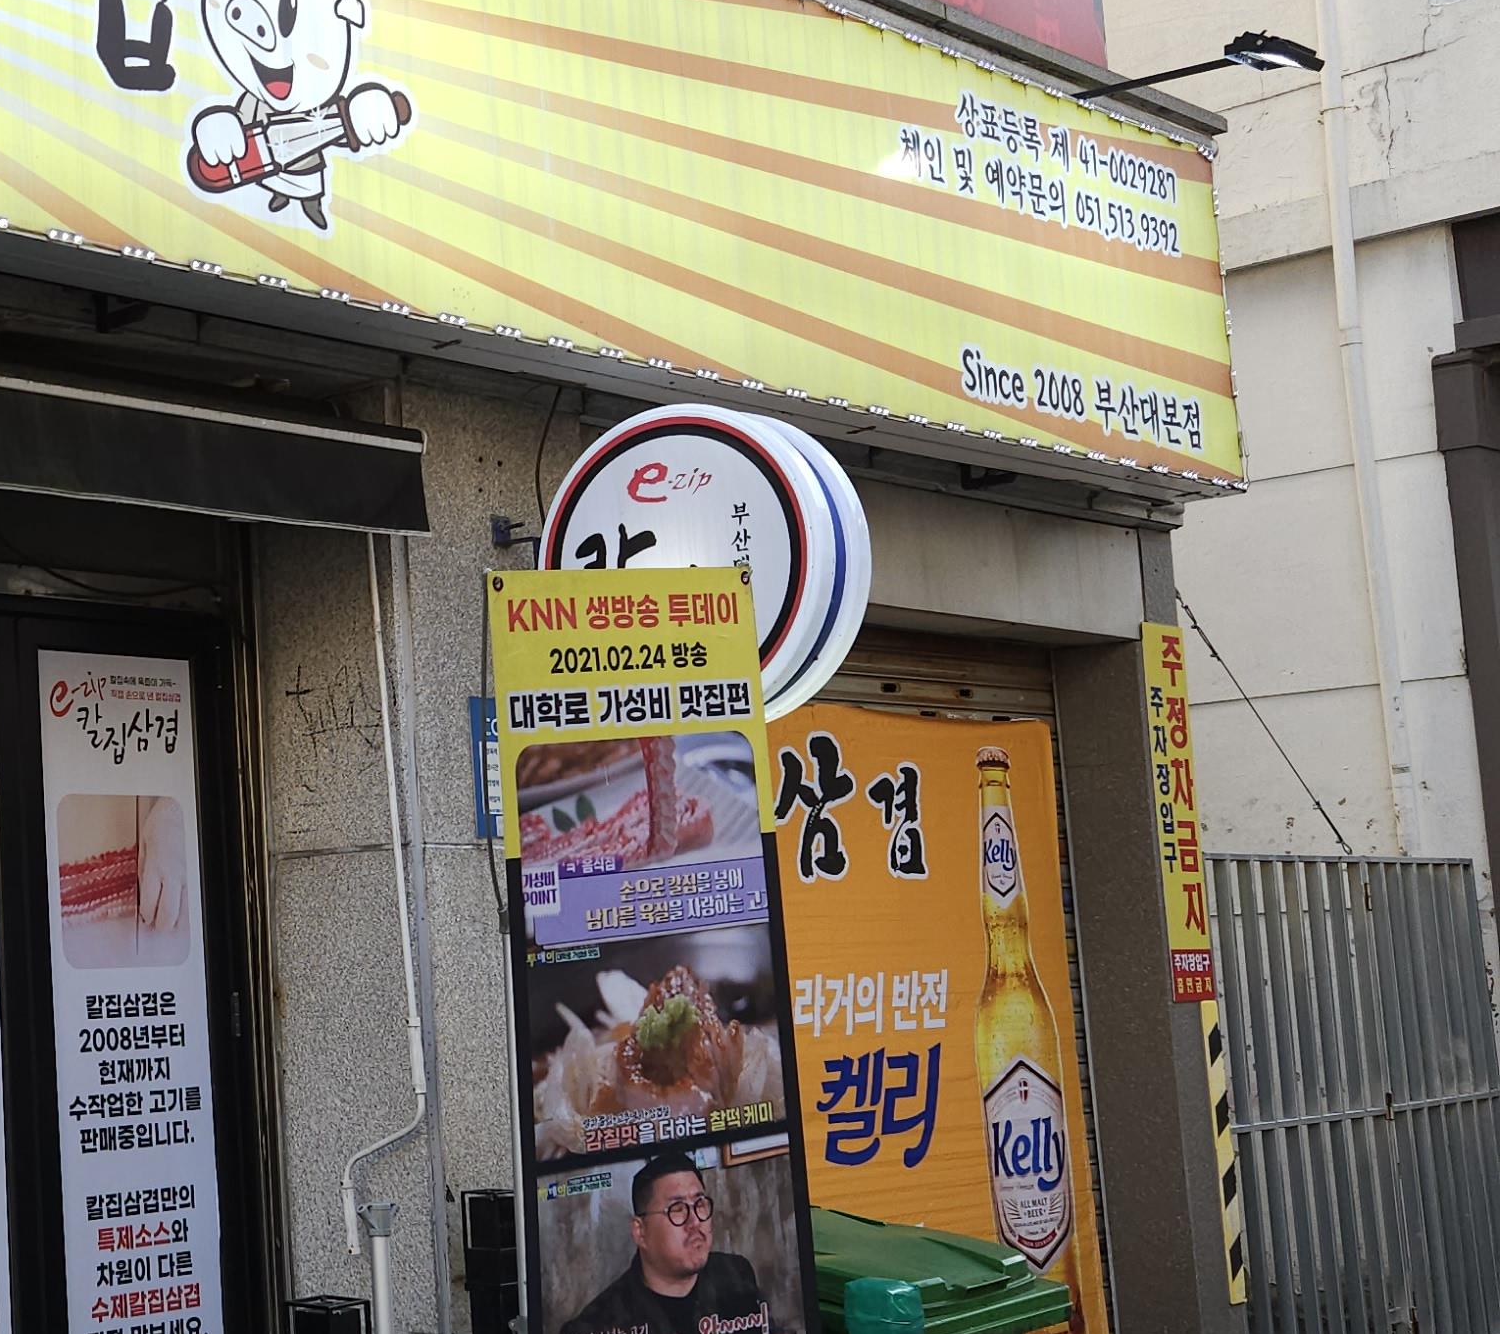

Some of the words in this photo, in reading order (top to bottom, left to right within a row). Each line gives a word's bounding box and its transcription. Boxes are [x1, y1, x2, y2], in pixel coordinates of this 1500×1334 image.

[957, 94, 1042, 161] 상표등록
[1050, 127, 1071, 174] 제
[1078, 138, 1177, 203] 41-0029287
[900, 128, 944, 185] 체인
[953, 148, 974, 194] 및
[985, 160, 1067, 224] 예약문의
[962, 349, 1025, 404] Since
[1034, 369, 1084, 416] 2008
[1095, 381, 1203, 451] 부산대본점
[507, 599, 578, 633] KNN
[586, 597, 660, 630] 생방송
[669, 593, 738, 627] 투데이
[550, 644, 666, 675] 2021.02.24
[671, 641, 708, 668] 방송
[511, 693, 591, 728] 대학로
[599, 689, 671, 723] 가성비
[679, 682, 751, 719] 맛집편
[77, 707, 180, 765] 칼집삼겹
[1150, 686, 1179, 874] 주차장입구
[1161, 634, 1207, 936] 주정차금지
[619, 877, 665, 903] 손으로
[585, 906, 636, 932] 남다른
[687, 895, 744, 919] 자랑하는
[85, 992, 177, 1020] 칼집삼겹은
[794, 971, 884, 1037] 라거의
[892, 969, 948, 1030] 반전
[78, 1022, 187, 1054] 2008년부터
[98, 1055, 171, 1086] 현재까지
[68, 1092, 144, 1122] 수작업한
[149, 1086, 202, 1114] 고기를
[817, 1042, 942, 1168] 켈리
[79, 1121, 196, 1155] 판매중입니다.
[585, 1123, 656, 1151] 감칠맛을
[659, 1118, 707, 1141] 더하는
[710, 1110, 741, 1133] 찰떡
[743, 1101, 773, 1125] 케미
[992, 1116, 1066, 1192] Kelly
[85, 1184, 196, 1222] 칼집삼겹만의
[96, 1219, 190, 1252] 특제소스와
[94, 1257, 152, 1288] 차원이
[157, 1250, 194, 1278] 다른
[91, 1282, 202, 1324] 수제칼집삼겹
